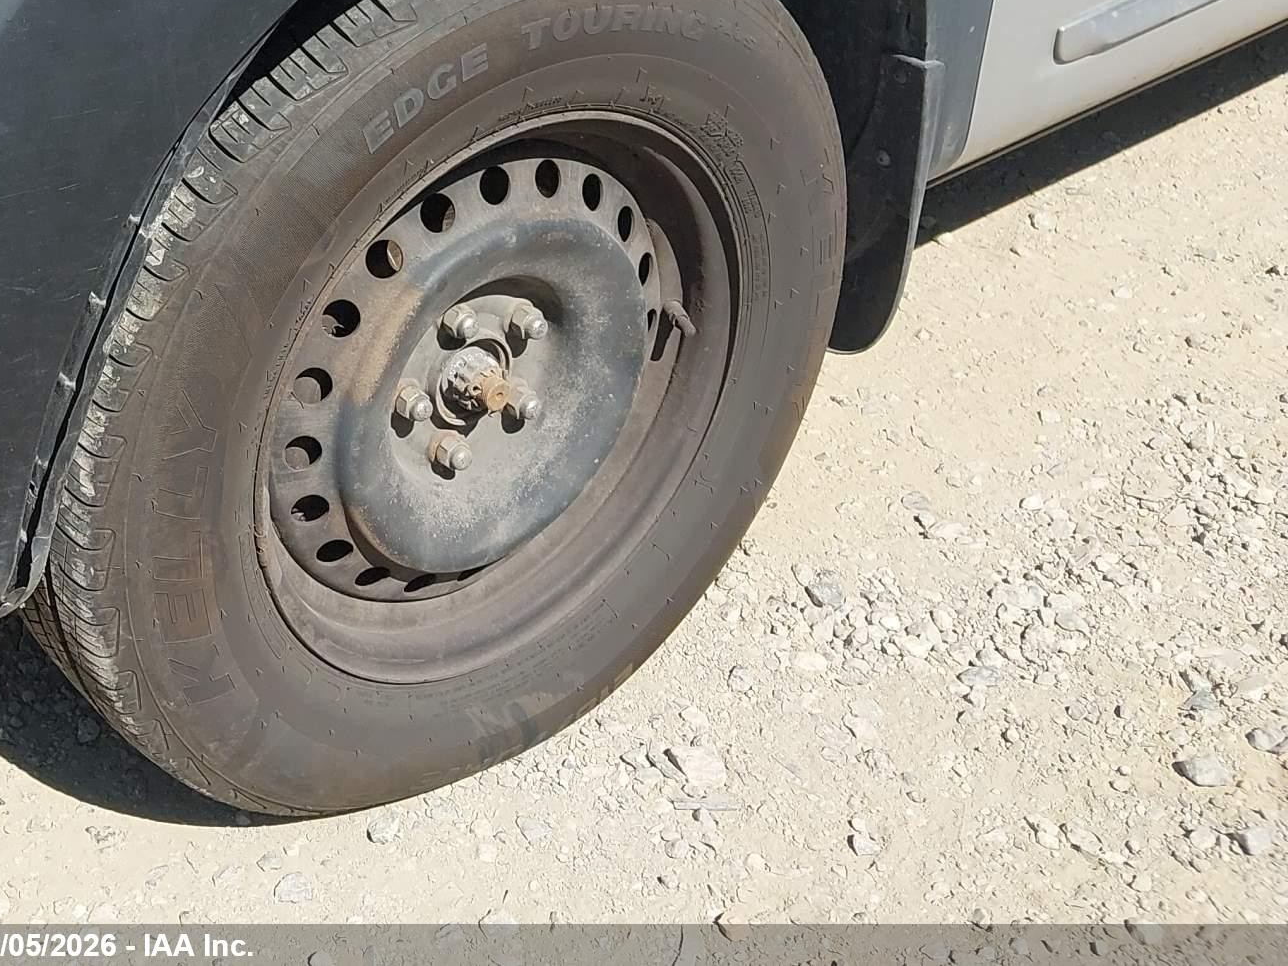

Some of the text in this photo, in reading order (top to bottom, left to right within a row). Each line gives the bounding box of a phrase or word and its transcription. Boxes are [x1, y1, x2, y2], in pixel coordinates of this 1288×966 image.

[362, 41, 490, 155] EDGE
[520, 2, 708, 52] TOURING
[151, 387, 239, 708] KELLY
